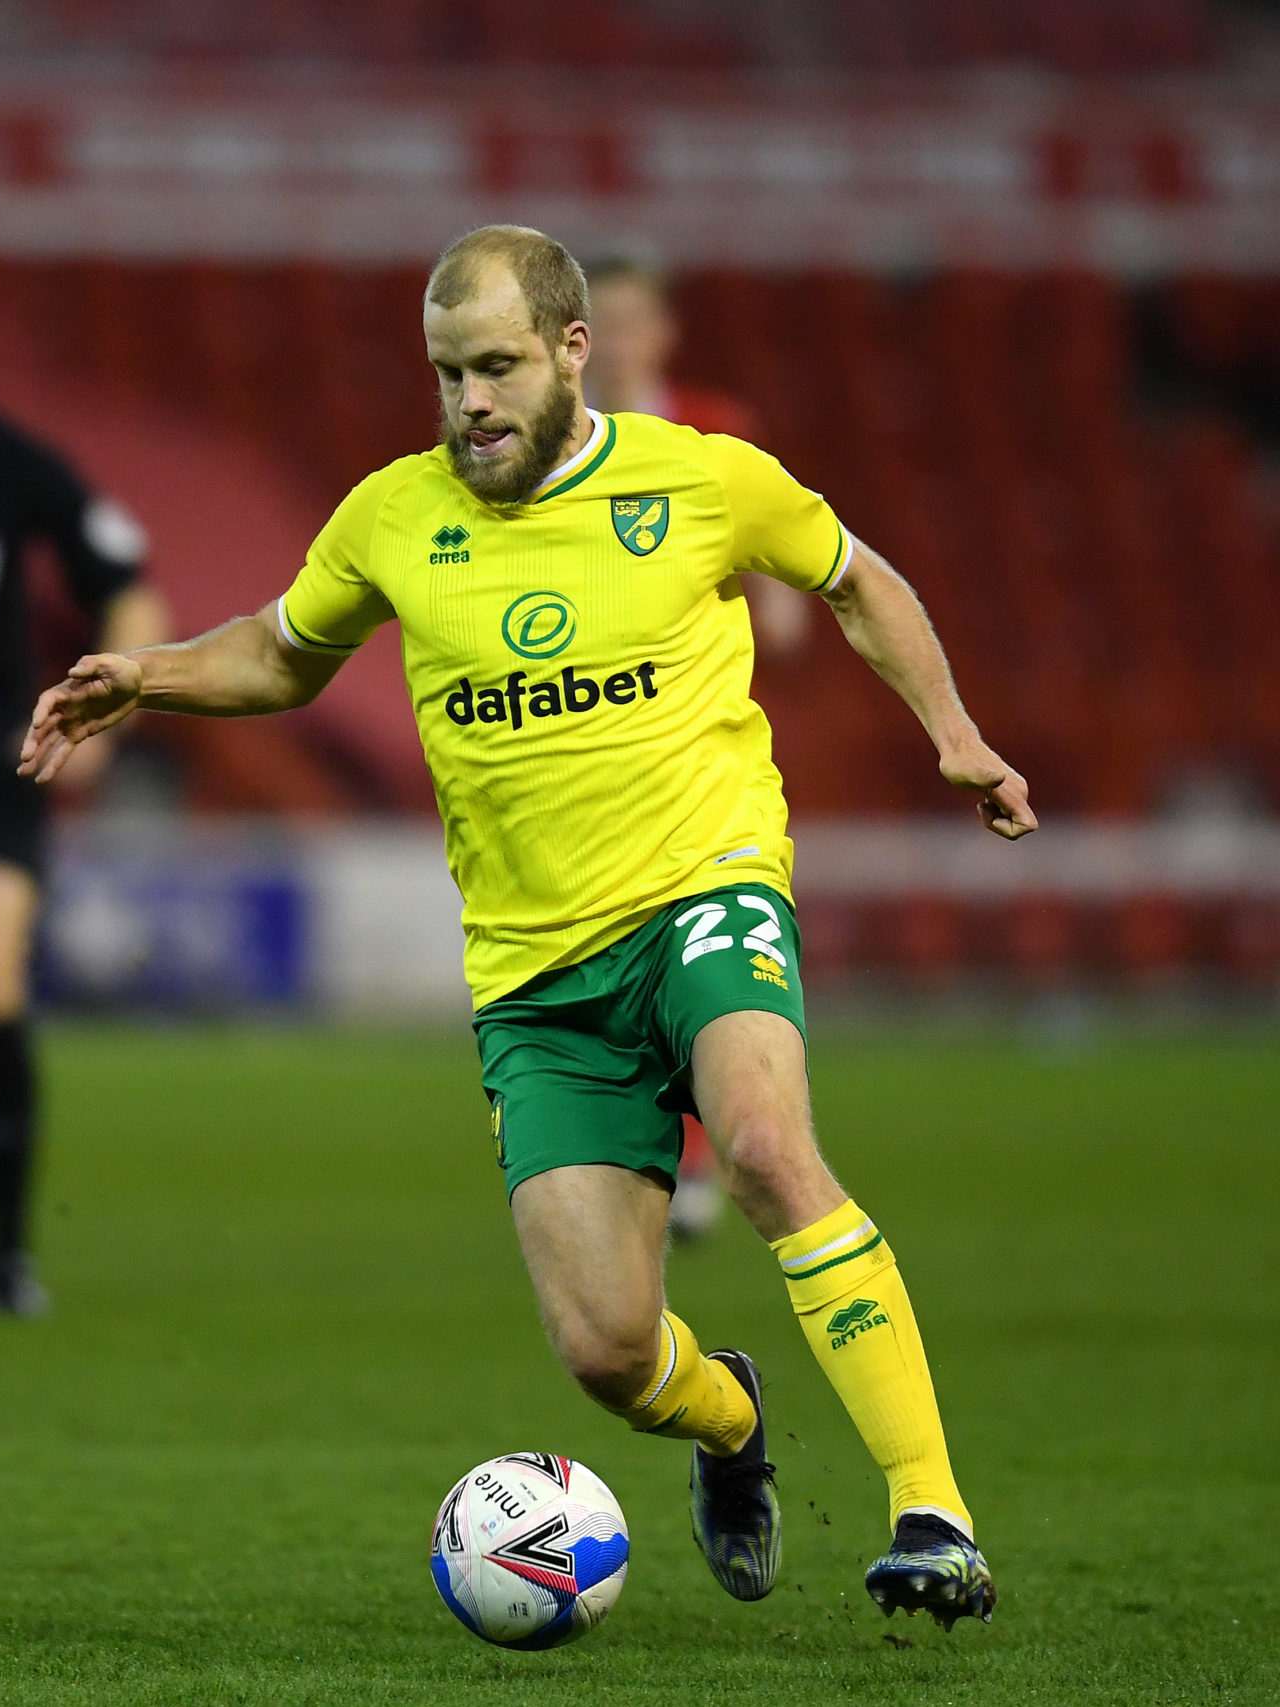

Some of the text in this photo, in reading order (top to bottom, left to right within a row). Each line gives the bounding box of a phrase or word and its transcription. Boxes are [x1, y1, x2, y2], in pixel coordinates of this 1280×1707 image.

[430, 550, 470, 565] errea
[445, 661, 659, 731] dafabet
[674, 894, 787, 968] 22
[753, 970, 789, 991] errea
[831, 1313, 889, 1350] errea
[475, 1473, 526, 1519] mitre
